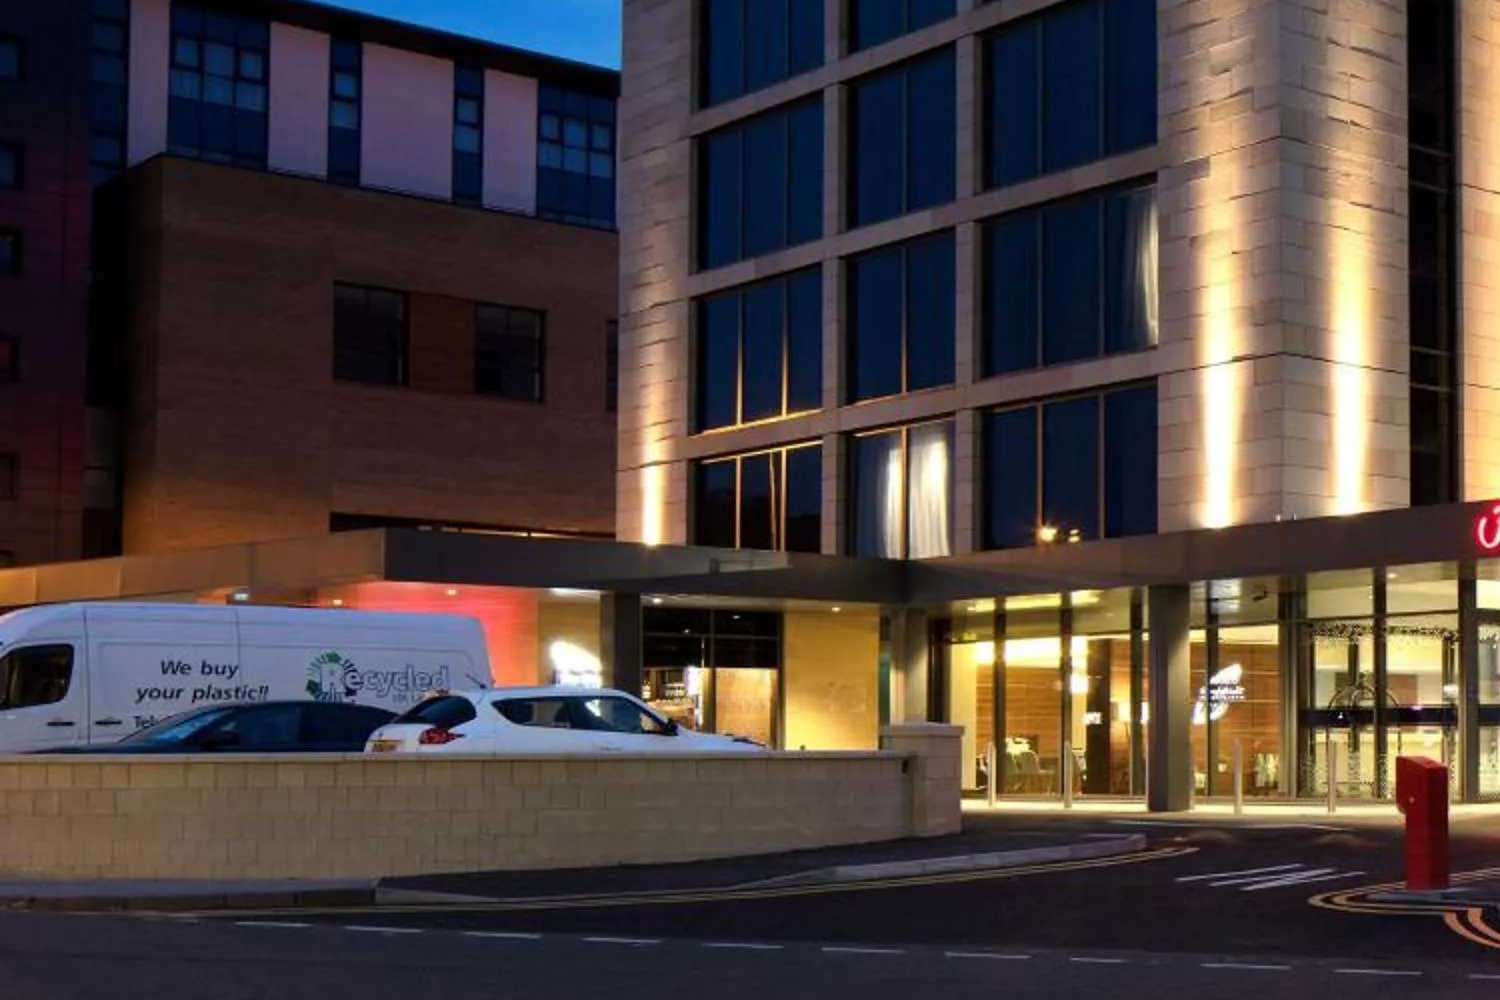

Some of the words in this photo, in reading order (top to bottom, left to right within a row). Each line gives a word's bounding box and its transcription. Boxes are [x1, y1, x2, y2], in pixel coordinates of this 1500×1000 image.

[161, 660, 192, 676] We
[201, 660, 239, 680] buy
[321, 664, 449, 698] Recycled
[134, 687, 184, 704] your
[192, 684, 269, 703] plastic!!
